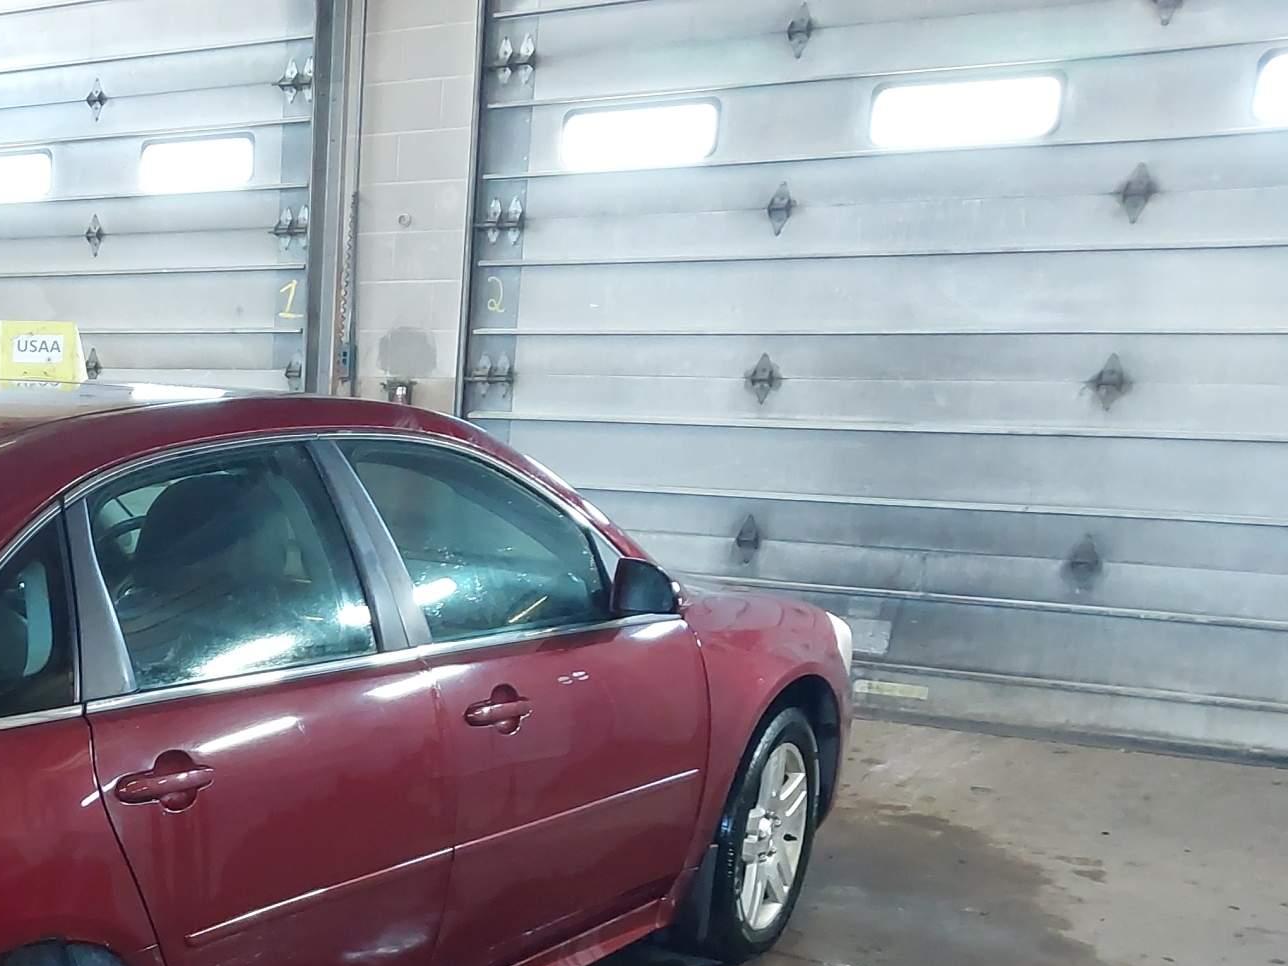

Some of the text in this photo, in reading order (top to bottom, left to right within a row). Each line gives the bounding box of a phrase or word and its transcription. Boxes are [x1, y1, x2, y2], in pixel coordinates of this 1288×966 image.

[278, 279, 304, 319] 1
[487, 276, 505, 313] 2
[17, 339, 61, 353] USAA
